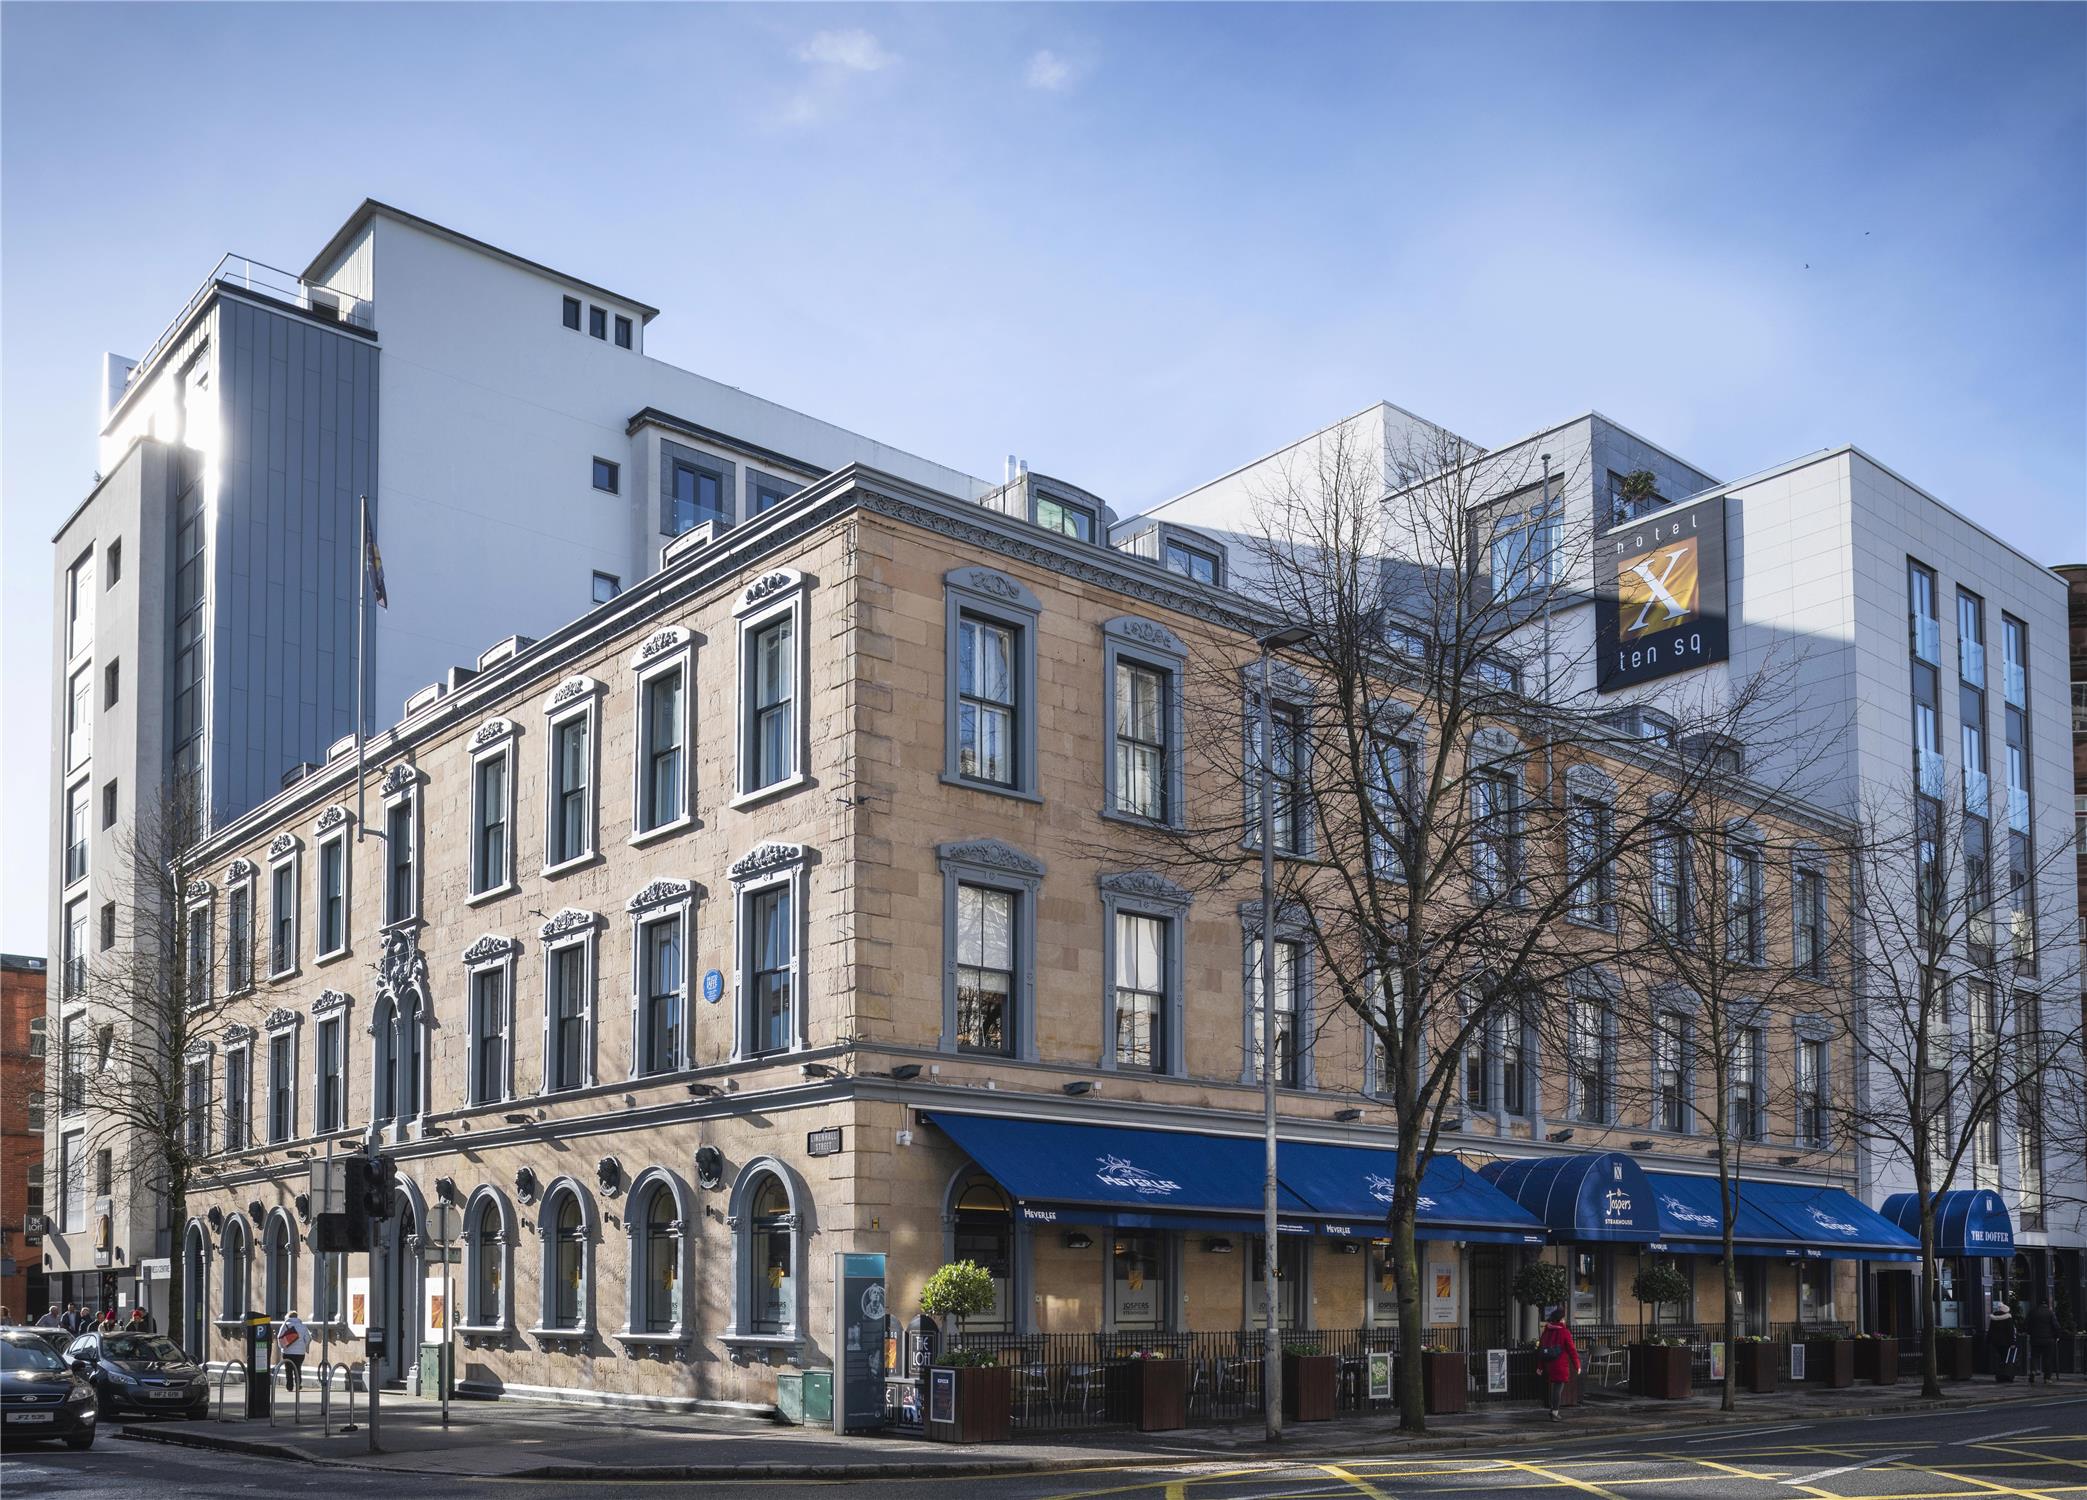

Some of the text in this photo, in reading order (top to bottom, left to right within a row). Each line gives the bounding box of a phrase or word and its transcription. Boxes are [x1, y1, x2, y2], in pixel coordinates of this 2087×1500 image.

[1617, 514, 1697, 554] hotel
[1626, 547, 1691, 632] X
[1619, 633, 1701, 672] ten sq
[815, 1141, 832, 1151] STREET
[1096, 1174, 1182, 1191] HEVERLEE
[1024, 1208, 1056, 1222] HEVERLEE
[1971, 1230, 2009, 1242] THE DOFFER
[257, 1326, 264, 1336] P
[915, 1336, 928, 1351] THE
[912, 1352, 931, 1366] LOFT
